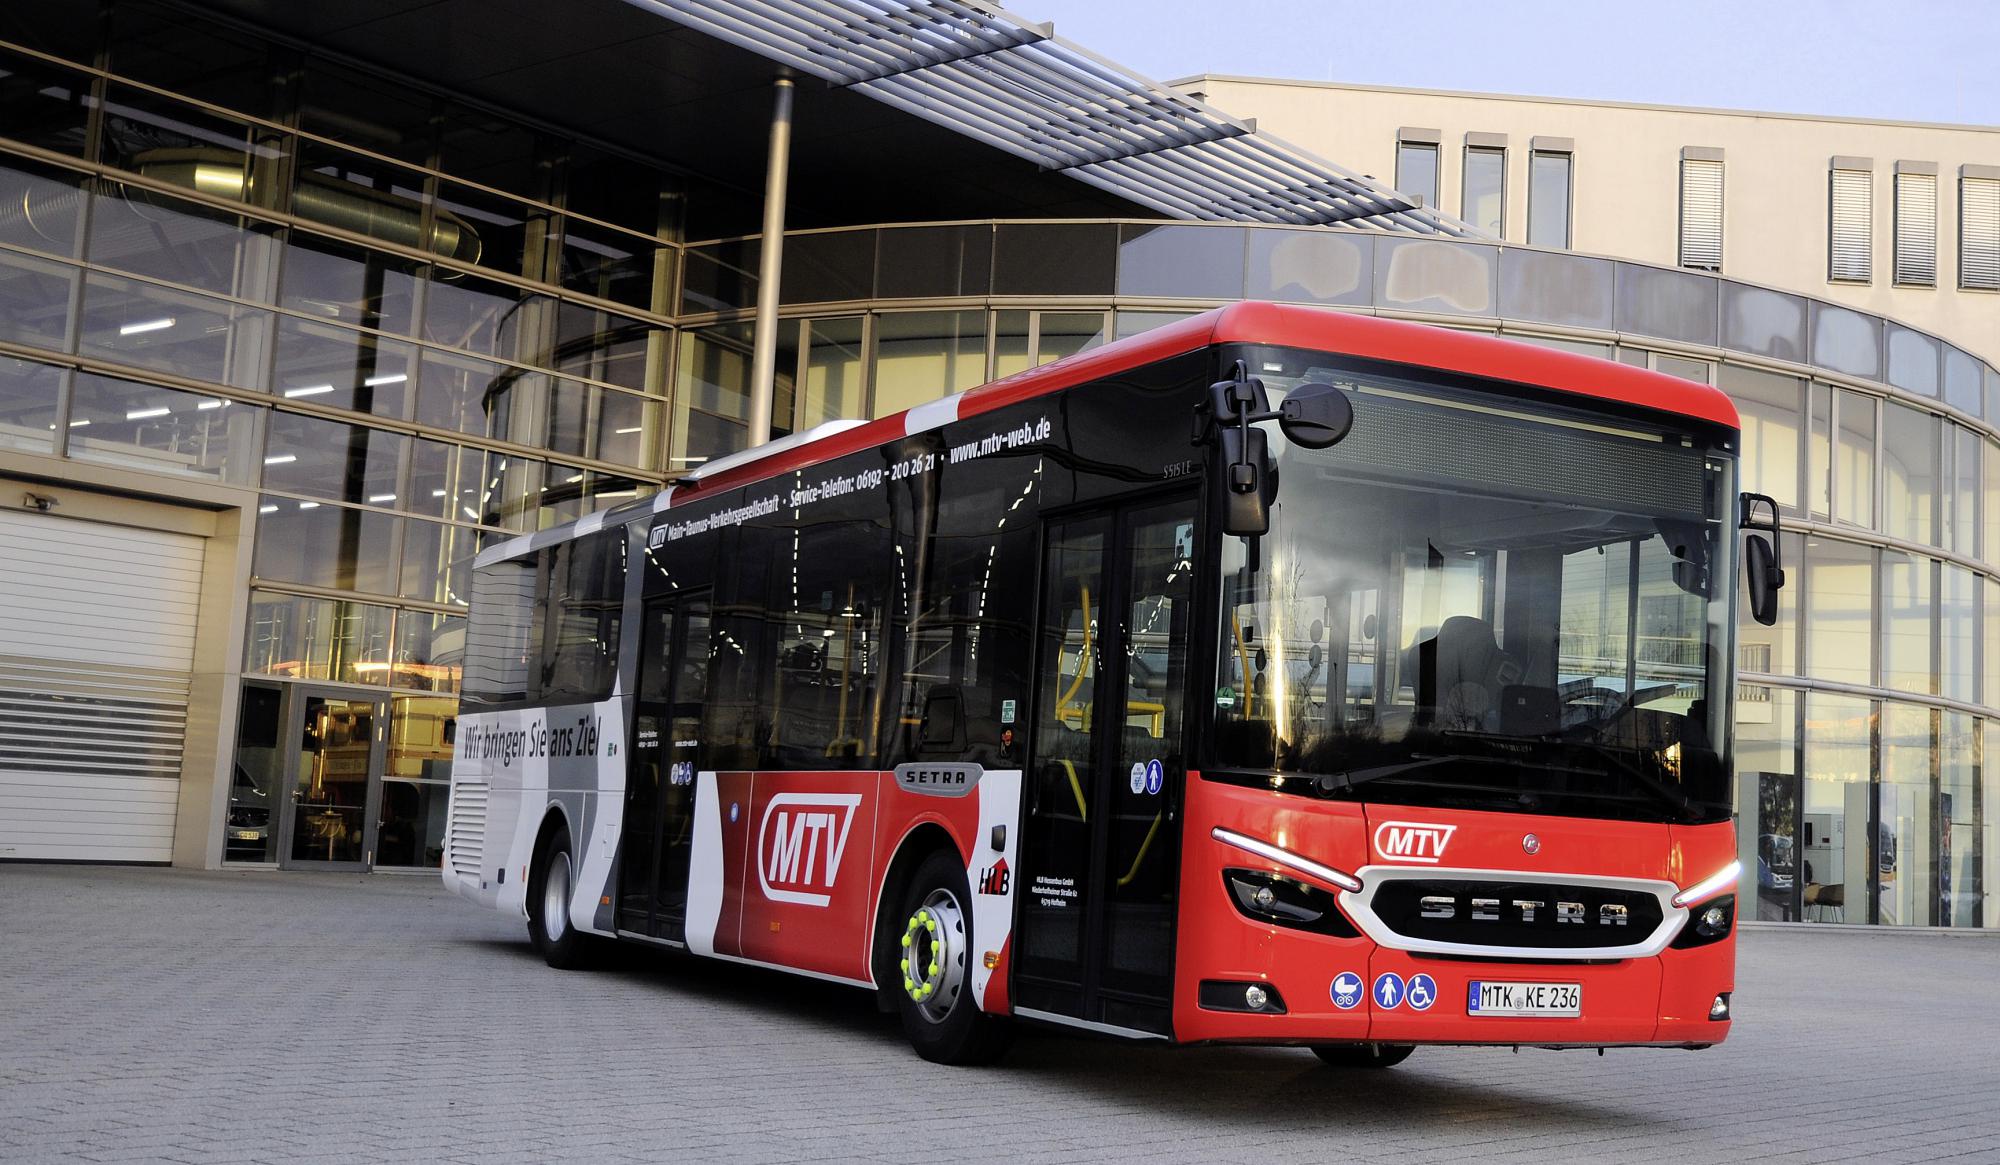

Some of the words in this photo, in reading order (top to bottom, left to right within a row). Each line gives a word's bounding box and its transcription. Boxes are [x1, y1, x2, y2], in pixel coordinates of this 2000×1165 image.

[651, 525, 667, 548] MTV
[668, 494, 779, 541] Main-Taunus-Verkehrsgesellschaft
[790, 477, 854, 508] Service-Telefon:
[856, 469, 882, 491] 06192
[891, 463, 909, 481] 200
[910, 454, 923, 476] 26
[925, 454, 935, 471] 21
[950, 416, 1050, 464] www.mtv-web.de
[464, 724, 482, 759] Wir
[484, 722, 526, 767] bringen
[529, 718, 547, 758] Sie
[550, 727, 573, 757] ans
[576, 715, 602, 756] Ziel
[906, 771, 966, 785] SETRA
[767, 799, 858, 888] MTV
[1384, 824, 1453, 858] MTV
[978, 867, 1010, 896] HLB
[1420, 896, 1628, 926] SETRA
[1481, 986, 1513, 1008] MTK
[1526, 987, 1545, 1008] KE
[1549, 987, 1578, 1008] 236
